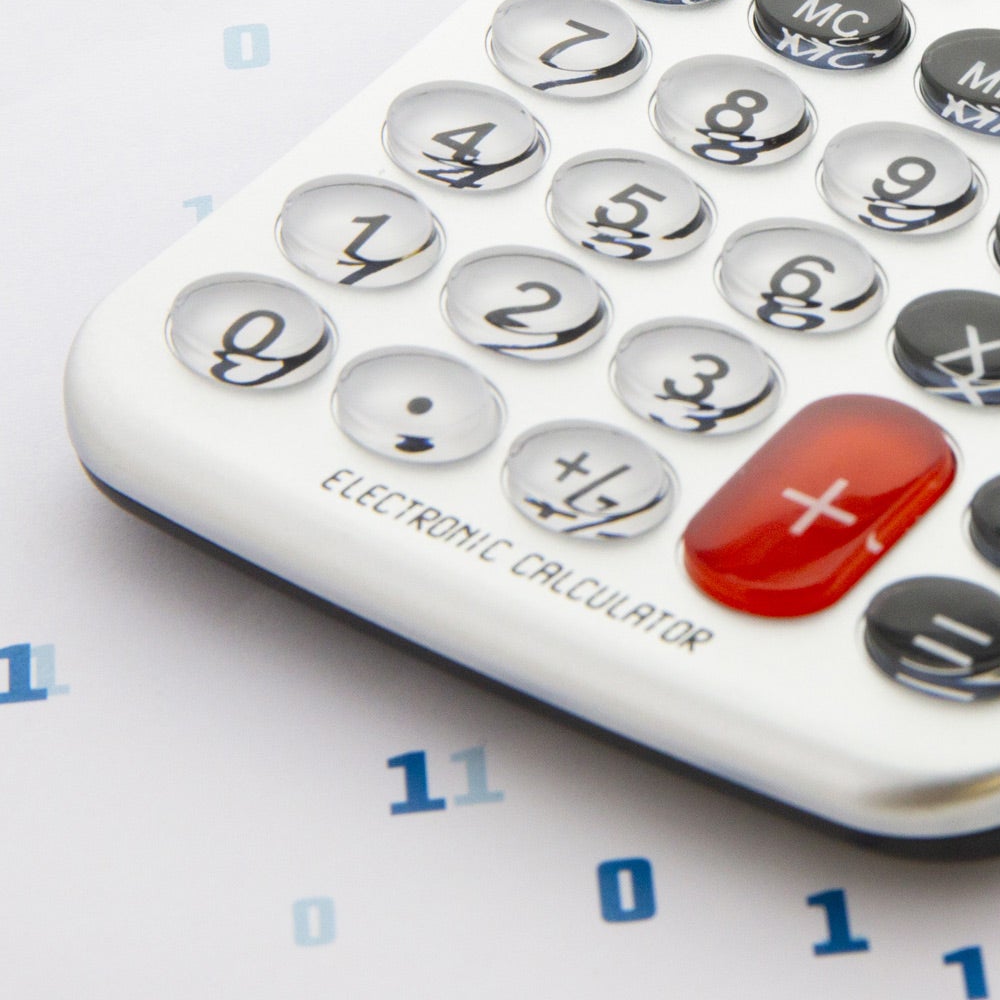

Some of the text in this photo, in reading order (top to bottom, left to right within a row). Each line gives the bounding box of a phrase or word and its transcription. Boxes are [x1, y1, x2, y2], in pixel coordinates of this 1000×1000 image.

[540, 19, 609, 70] 7
[704, 90, 768, 139] 8
[431, 122, 497, 166] 4
[872, 157, 936, 202] 9
[594, 183, 667, 234] 5
[485, 281, 562, 328] 2
[769, 255, 836, 303] 6
[221, 310, 286, 358] 0
[663, 354, 729, 406] 3
[321, 468, 715, 654] ELECTRONIC CALCULATOR
[0, 643, 48, 704] 1
[387, 750, 448, 815] 1
[598, 856, 658, 922] 0
[806, 888, 870, 956] 1
